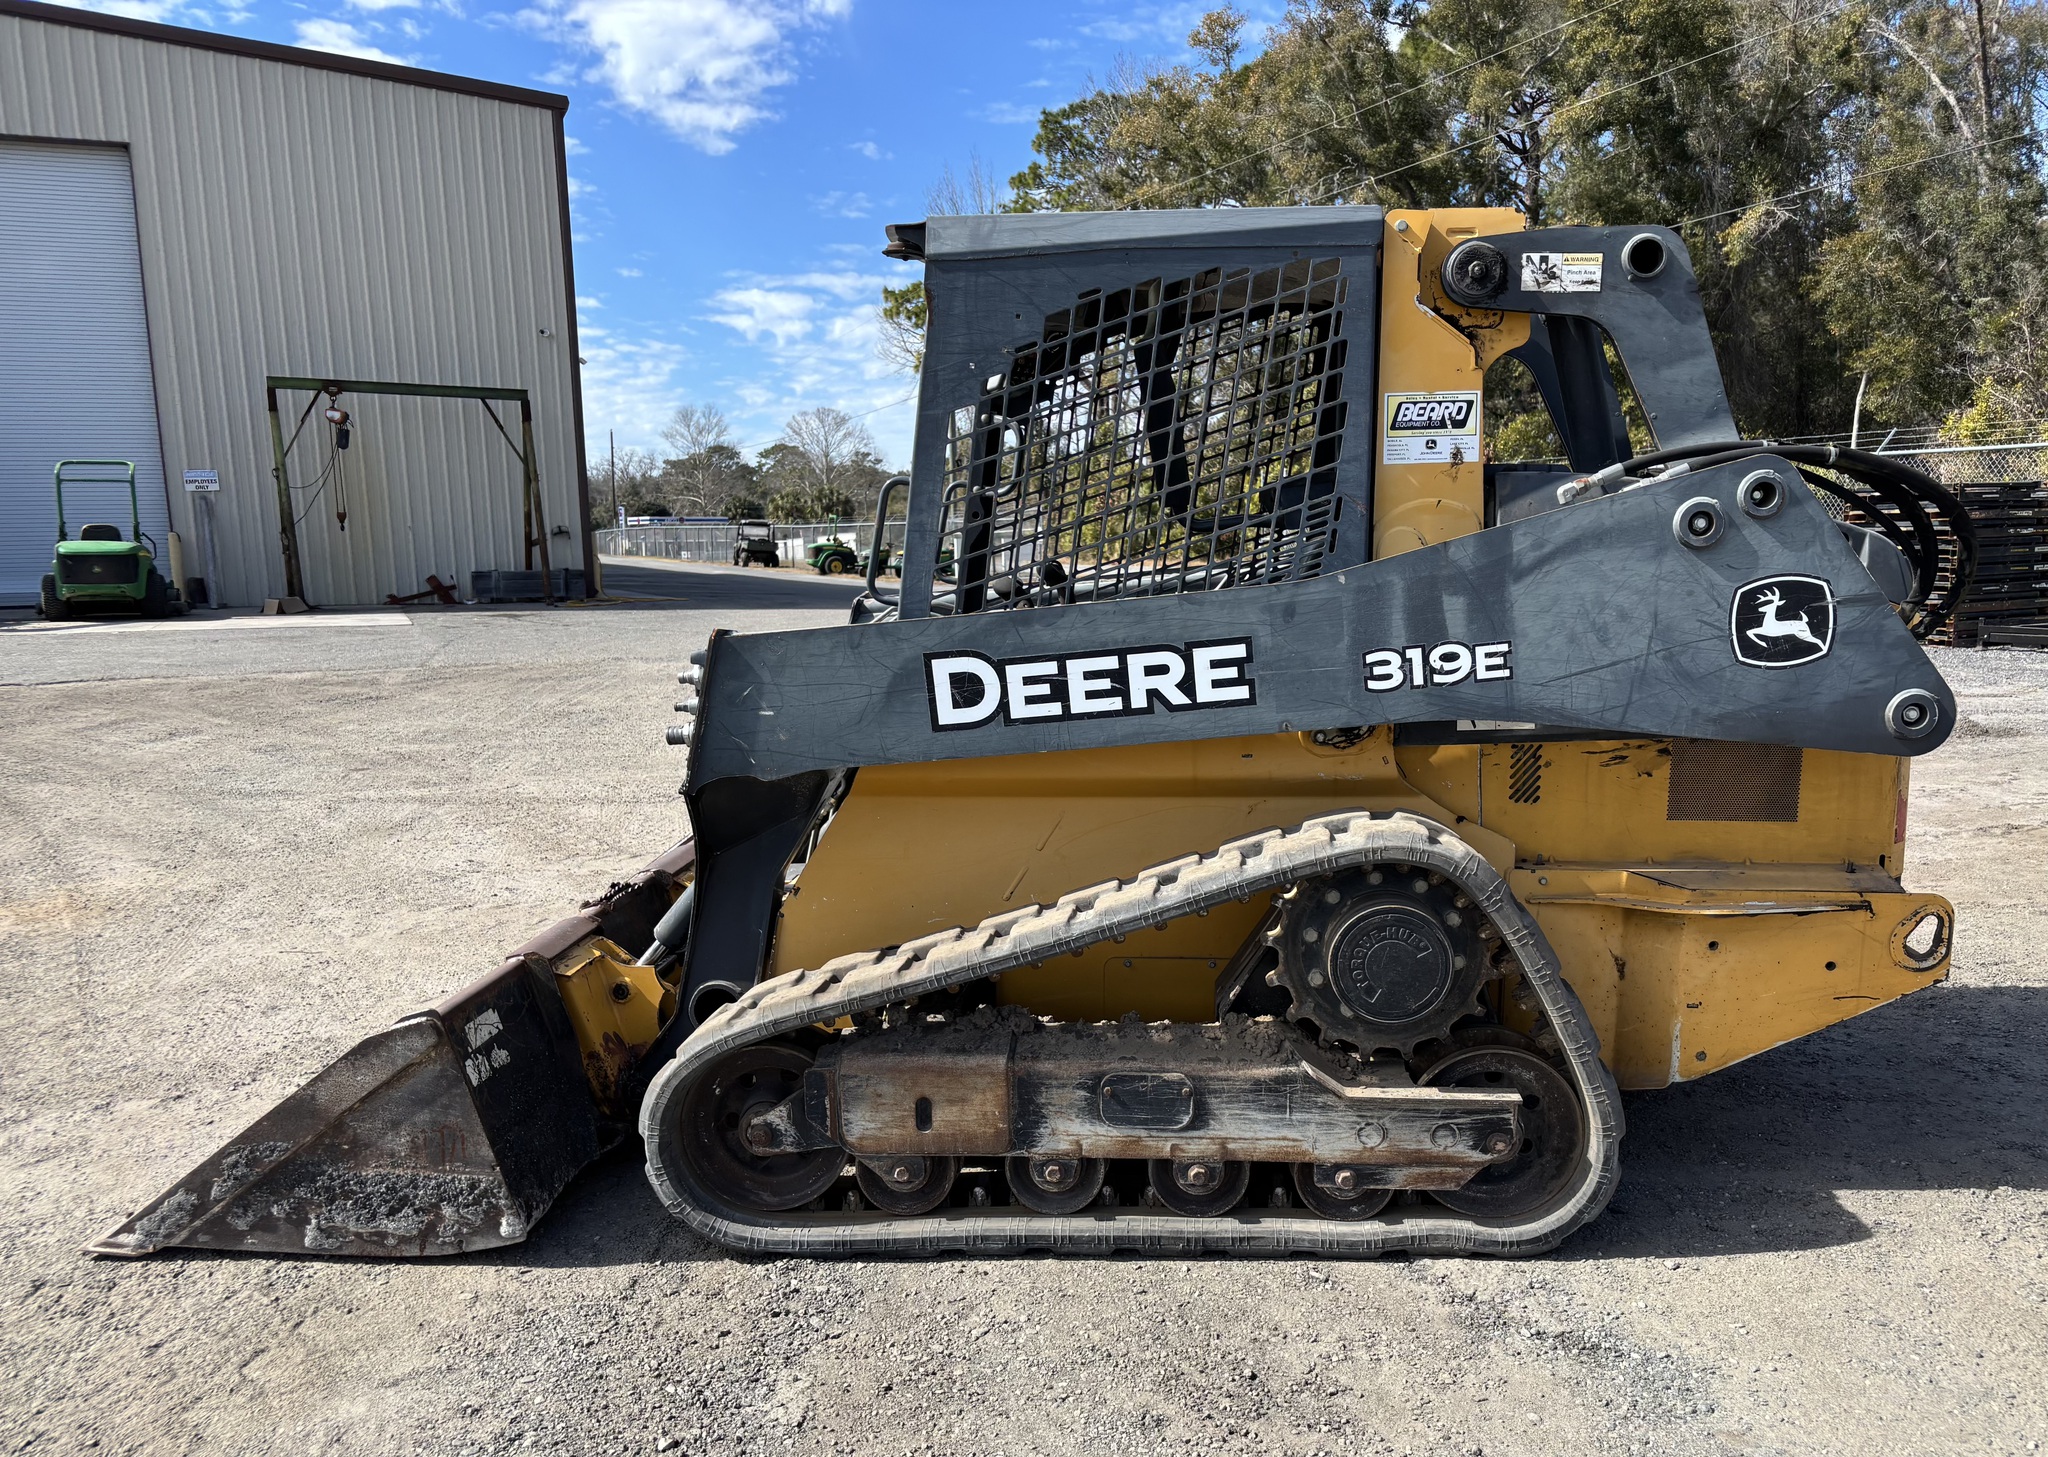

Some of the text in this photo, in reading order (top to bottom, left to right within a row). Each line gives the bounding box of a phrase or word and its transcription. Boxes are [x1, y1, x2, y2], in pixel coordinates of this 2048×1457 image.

[1395, 420, 1430, 428] EQUIPMENT
[1396, 402, 1468, 429] BEARD
[930, 643, 1251, 726] DEERE
[1365, 643, 1511, 690] 319E
